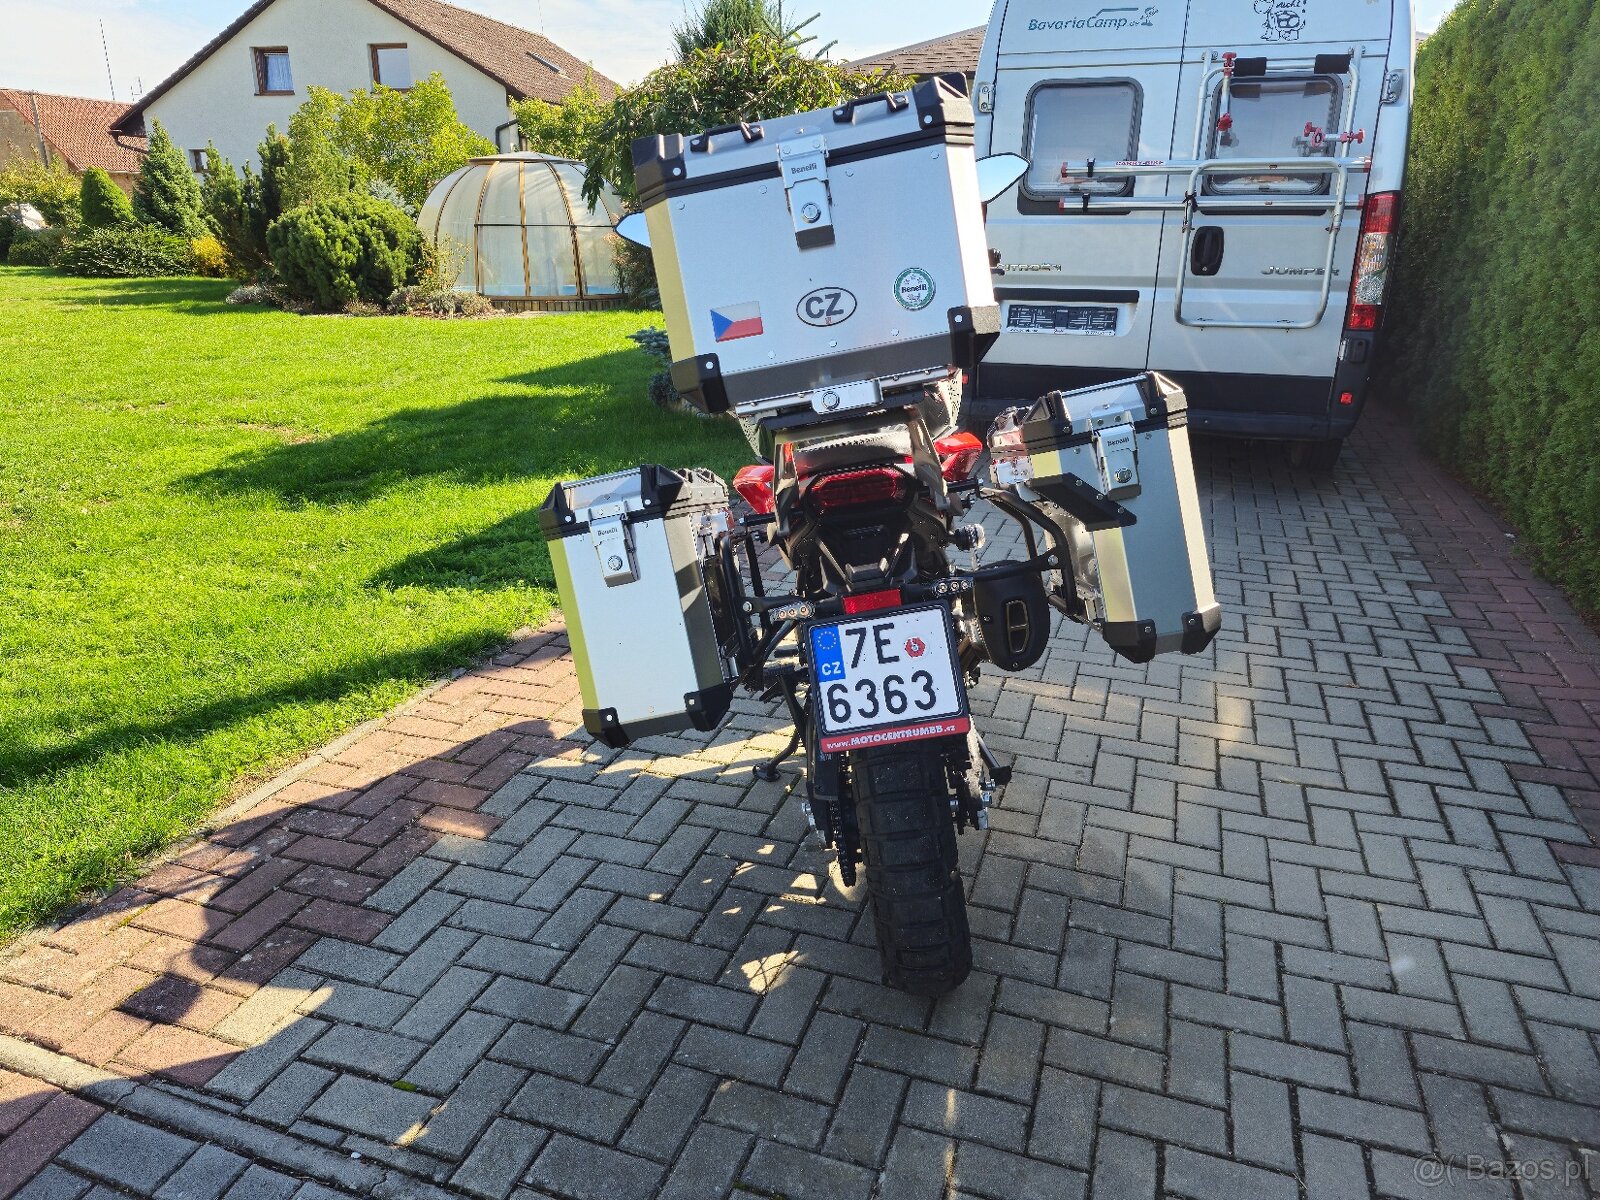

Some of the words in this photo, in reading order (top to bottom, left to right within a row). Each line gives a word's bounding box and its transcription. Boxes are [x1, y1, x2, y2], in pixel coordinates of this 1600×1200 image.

[791, 163, 817, 174] Benelli
[901, 284, 927, 294] Benelli
[805, 292, 845, 319] CZ
[845, 622, 900, 669] 7E
[821, 661, 842, 676] CZ
[826, 669, 937, 723] 6363
